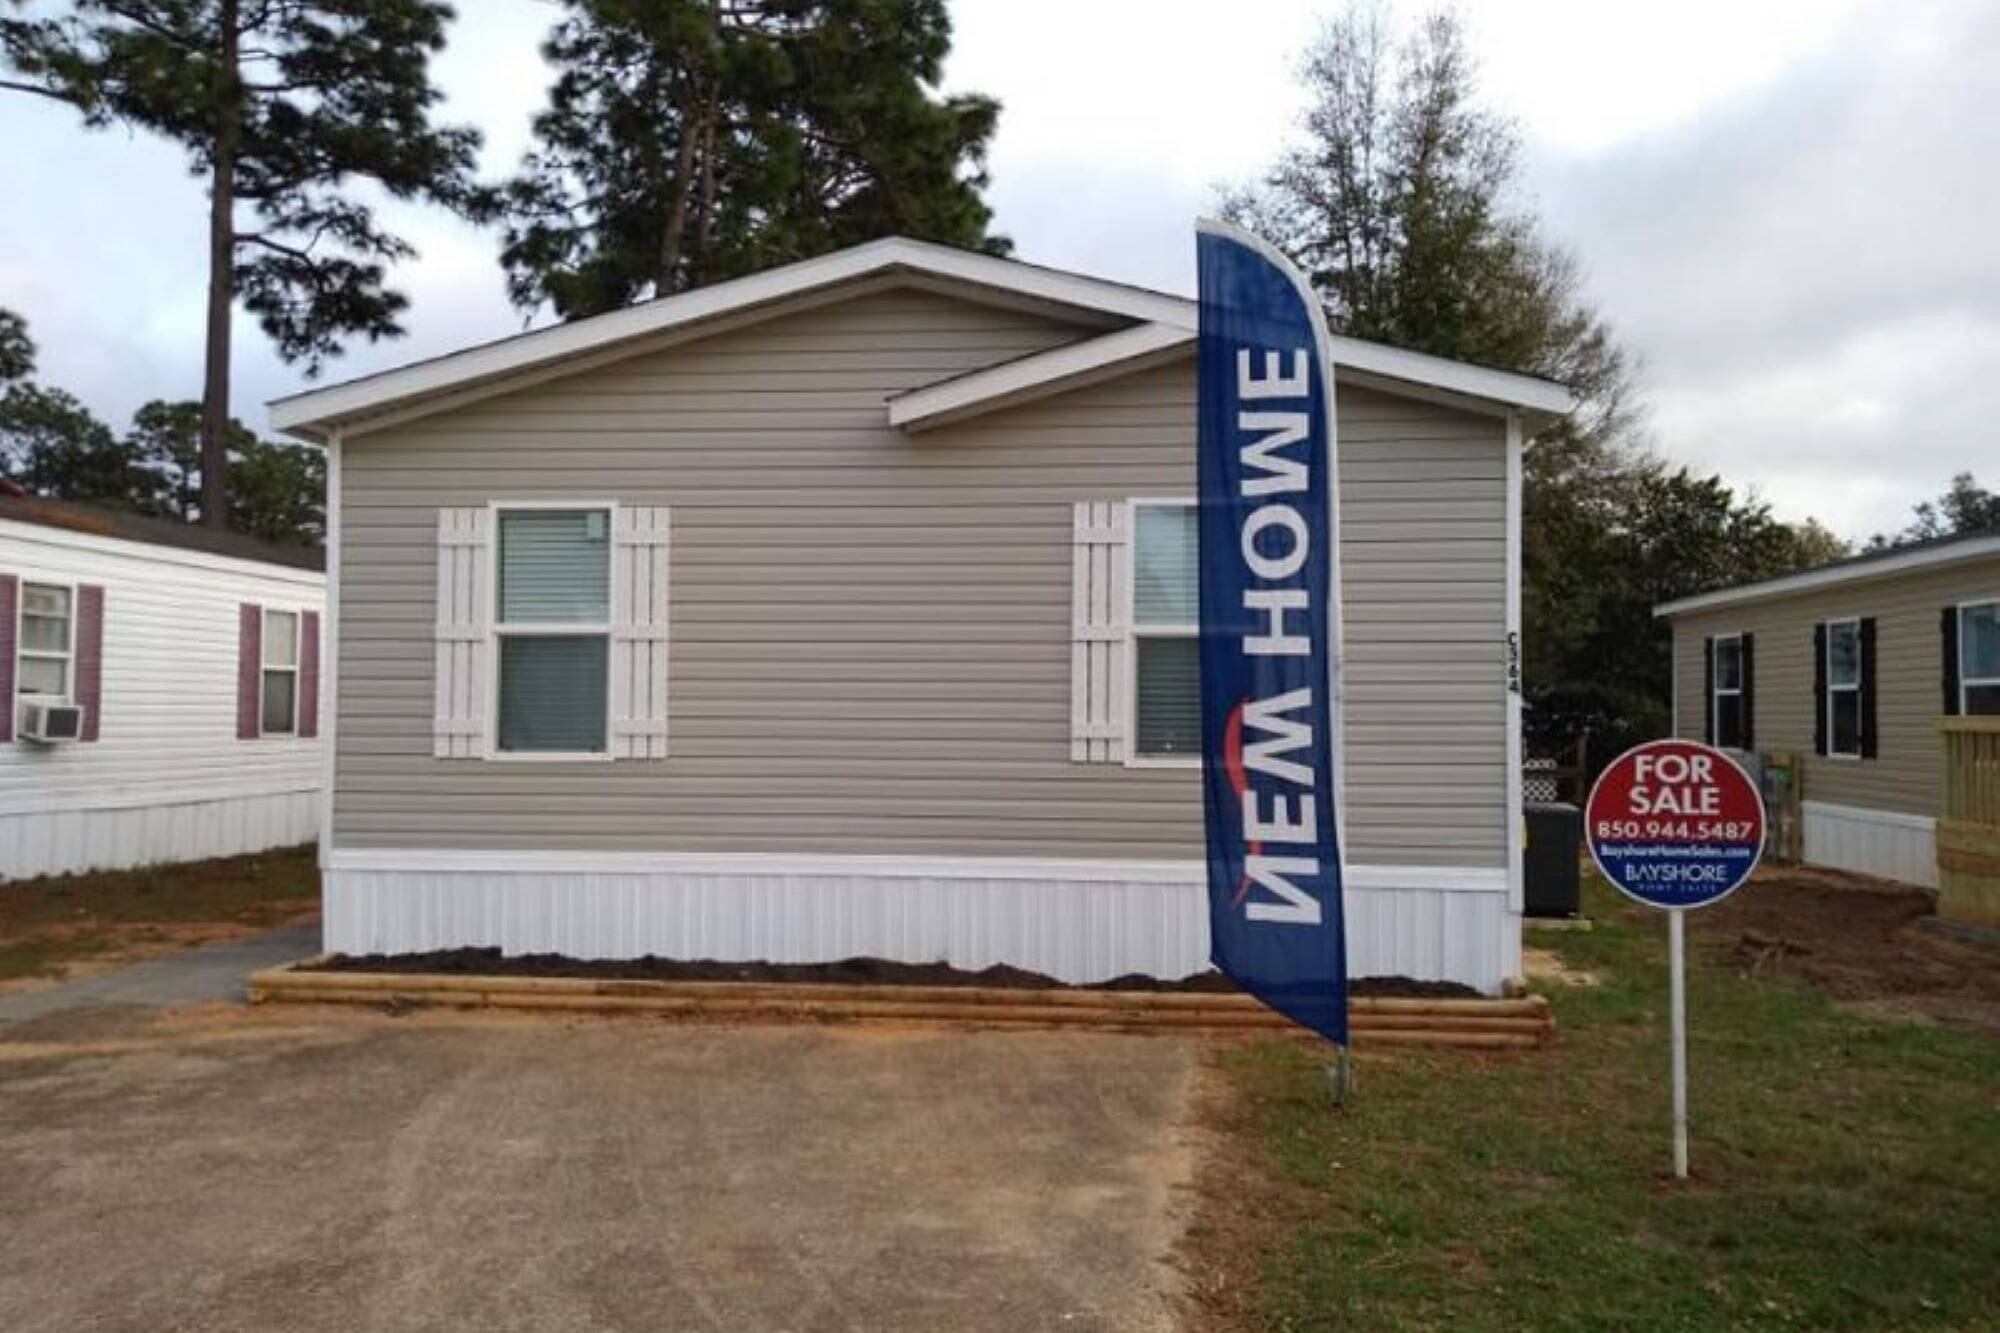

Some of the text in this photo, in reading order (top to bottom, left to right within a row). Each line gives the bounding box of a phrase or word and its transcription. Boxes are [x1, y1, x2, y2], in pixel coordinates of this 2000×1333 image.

[1634, 754, 1715, 783] FOR
[1628, 786, 1720, 815] SALE
[1598, 821, 1753, 839] 850.944.5487
[1626, 864, 1728, 882] BAYSHORE
